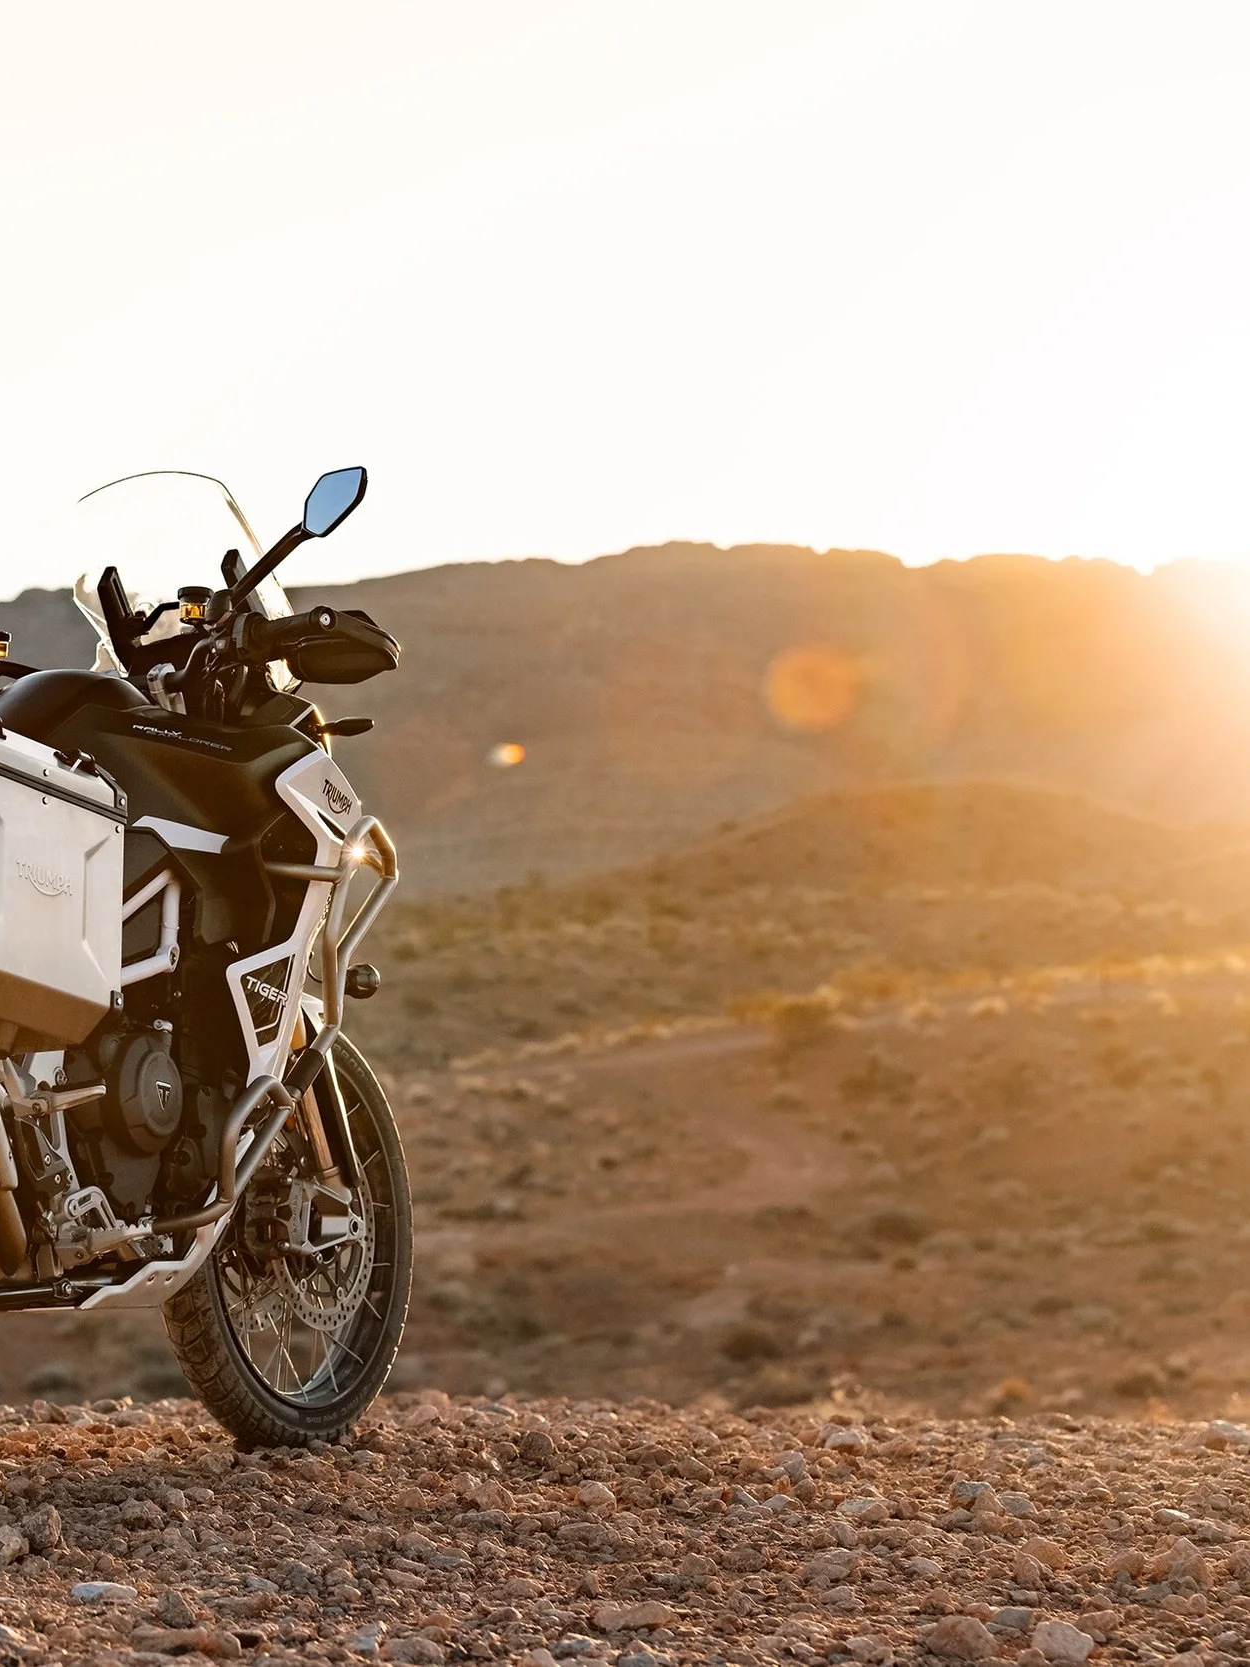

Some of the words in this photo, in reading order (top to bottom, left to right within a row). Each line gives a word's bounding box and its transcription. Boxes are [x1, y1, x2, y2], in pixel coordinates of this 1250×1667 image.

[132, 724, 183, 737] RALLY
[322, 778, 353, 815] TRIUMPH
[14, 856, 73, 897] TRIUMPH
[246, 975, 289, 1008] TIGER
